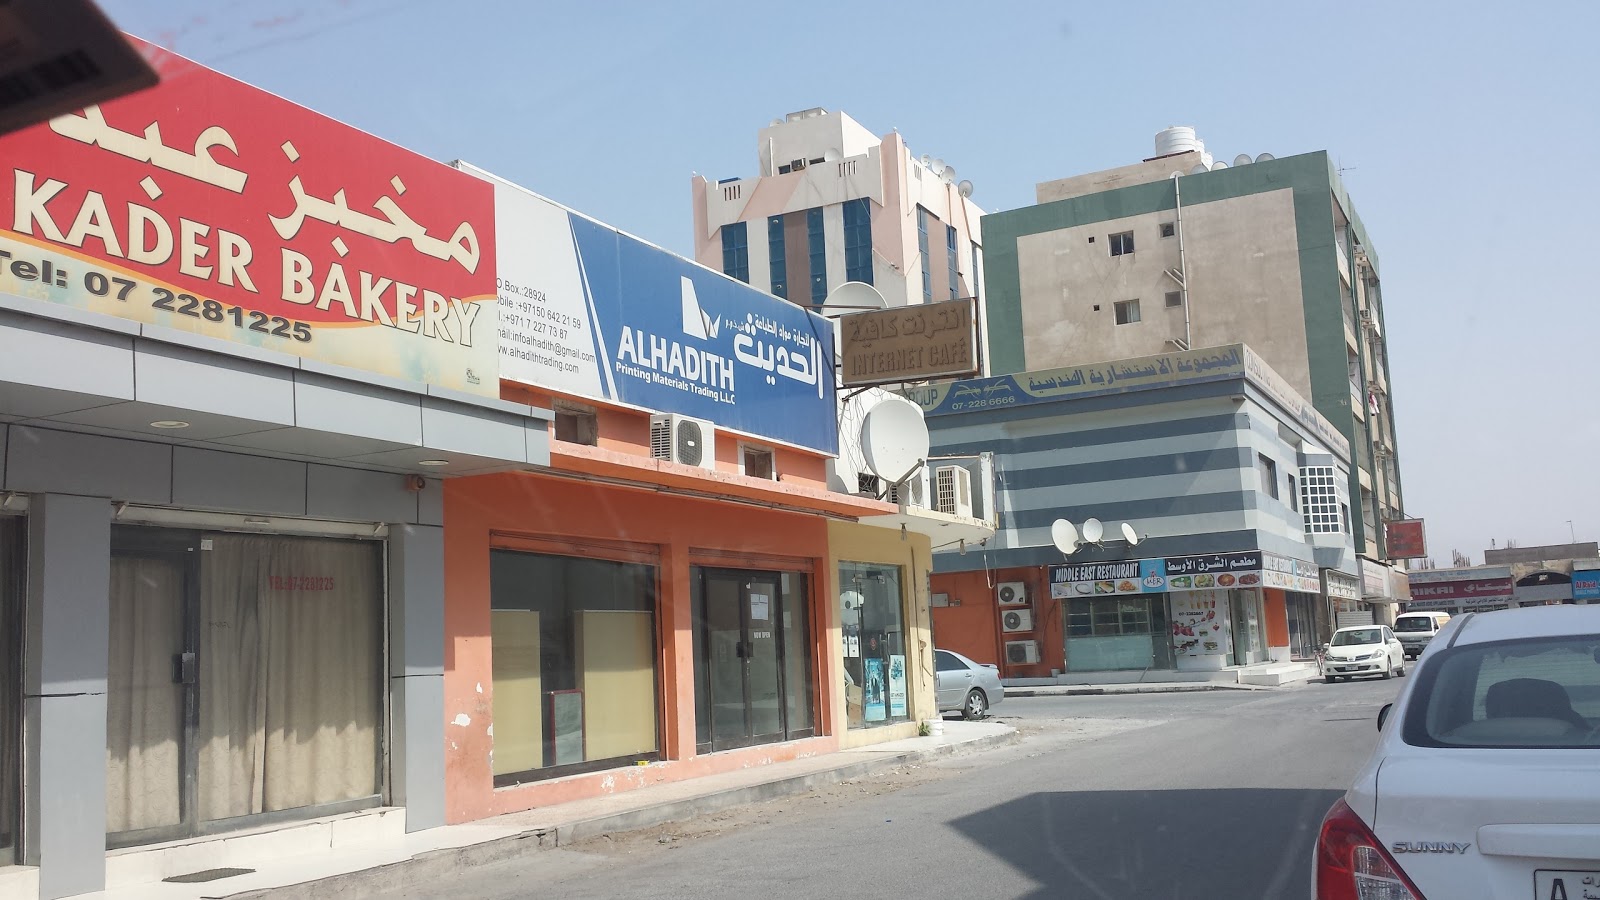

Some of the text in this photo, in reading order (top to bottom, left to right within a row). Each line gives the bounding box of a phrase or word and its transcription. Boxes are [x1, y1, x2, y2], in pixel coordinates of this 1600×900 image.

[268, 140, 480, 275] مخبز
[12, 168, 481, 347] KADER BAKERY
[84, 271, 137, 302] 07
[152, 286, 312, 343] 2281225
[547, 310, 560, 322] 642
[562, 314, 570, 325] 21
[573, 318, 581, 329] 59
[527, 318, 531, 329] 7
[533, 320, 546, 333] 227
[549, 326, 557, 337] 73
[617, 325, 735, 392] ALHADITH
[733, 312, 824, 399] الحديث
[851, 346, 924, 376] INTERNET
[1176, 348, 1240, 373] المجموعة
[615, 361, 651, 384] Printing
[652, 372, 688, 391] Materials
[689, 382, 718, 401] Trading
[1090, 357, 1174, 386] الاستشارية
[951, 395, 1016, 411] 07-228 6666
[1055, 562, 1139, 582] MIDDLE EAST RESTAURANT
[1198, 555, 1228, 572] الشرق
[1229, 556, 1257, 570] مطعم
[1391, 841, 1471, 855] SUNNY
[1551, 878, 1568, 900] A
